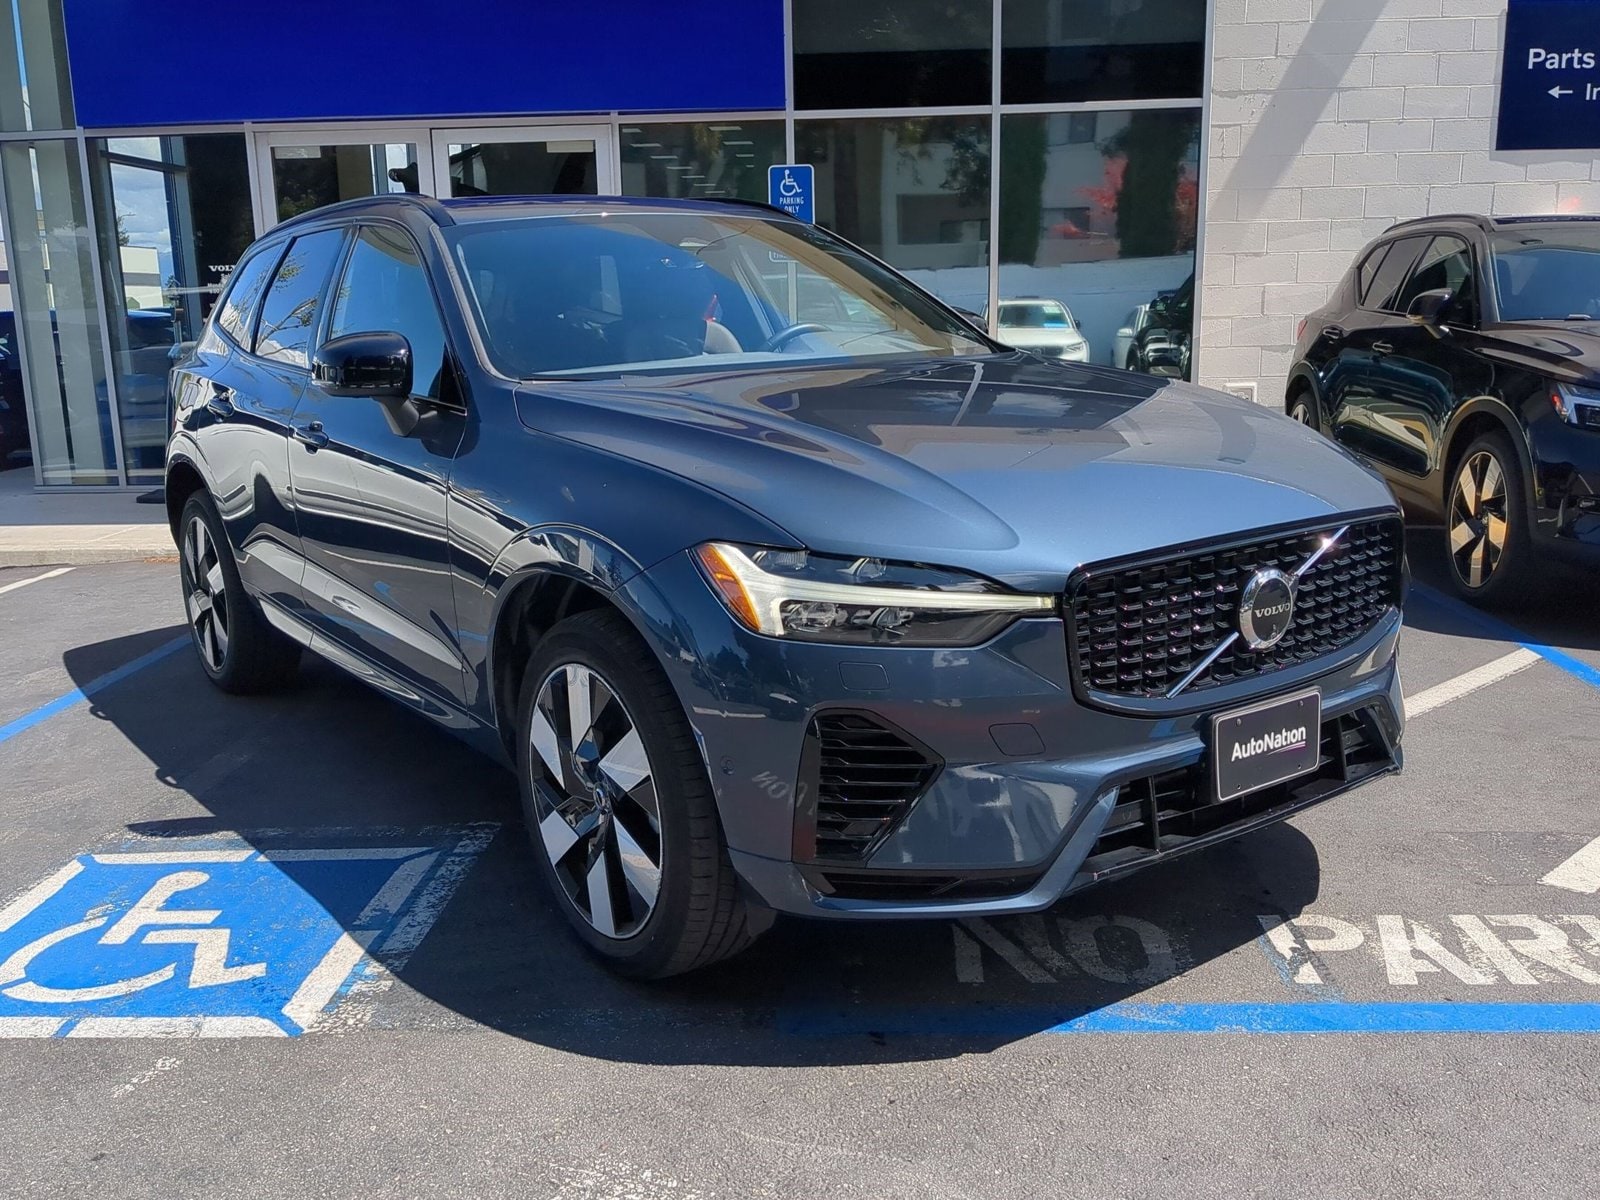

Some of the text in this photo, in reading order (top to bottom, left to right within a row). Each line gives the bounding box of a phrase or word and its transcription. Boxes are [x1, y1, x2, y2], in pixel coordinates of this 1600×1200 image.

[1528, 48, 1595, 69] Parts
[780, 197, 805, 205] PARKING
[1255, 603, 1291, 618] VOLVO
[1231, 727, 1306, 762] AutoNation
[952, 914, 1182, 984] NO
